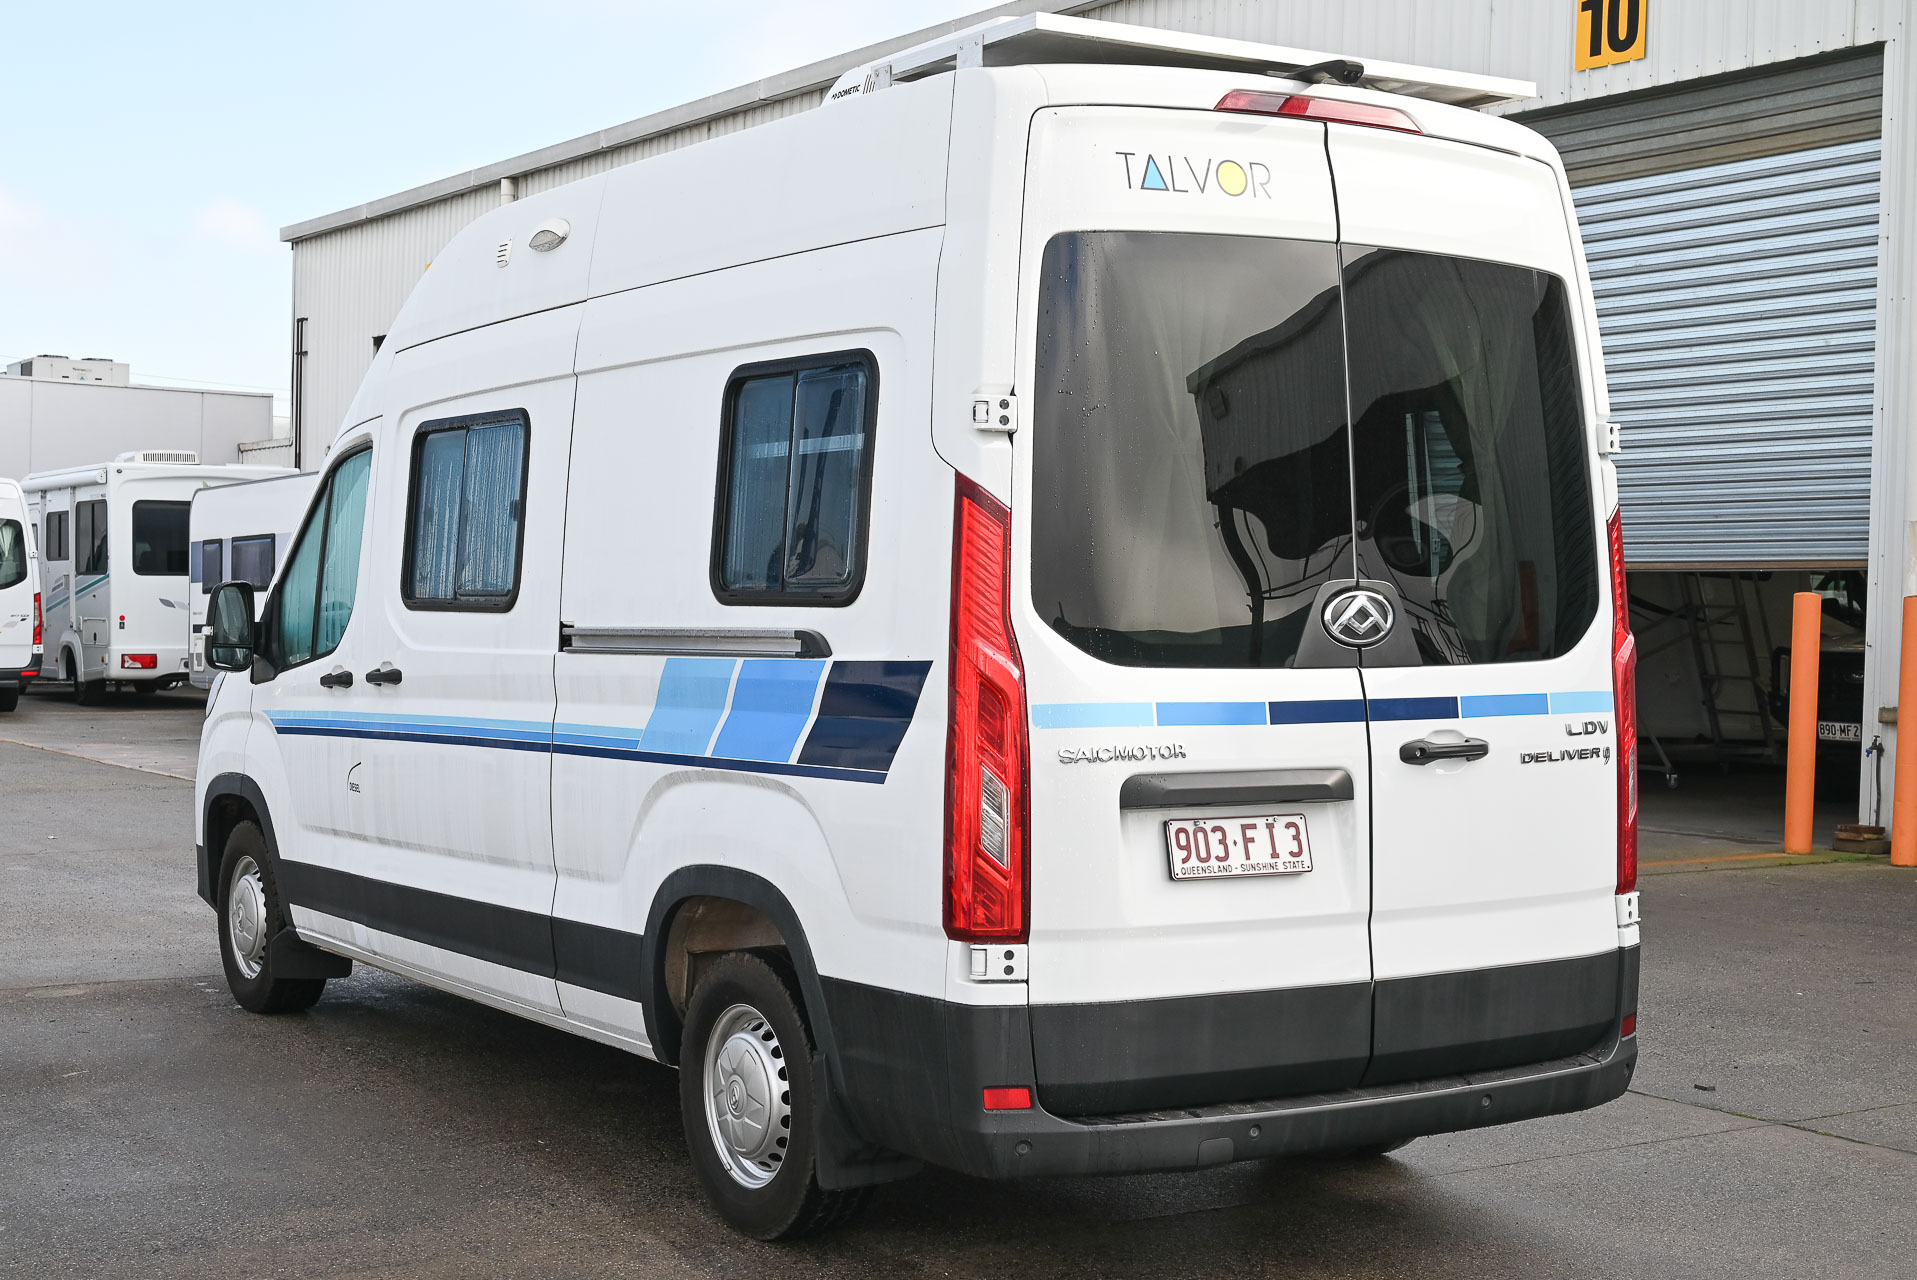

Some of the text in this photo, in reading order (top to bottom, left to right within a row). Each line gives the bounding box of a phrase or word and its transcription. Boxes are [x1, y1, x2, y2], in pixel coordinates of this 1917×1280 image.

[1581, 0, 1640, 57] 10
[836, 84, 861, 100] DOMETIC
[1115, 151, 1272, 199] TALVOR
[1565, 720, 1609, 736] LDV
[1520, 747, 1601, 765] DELIVER
[1180, 864, 1233, 876] QUEENSLAND
[1240, 861, 1280, 872] SUNSHINE
[1282, 860, 1306, 870] STATE
